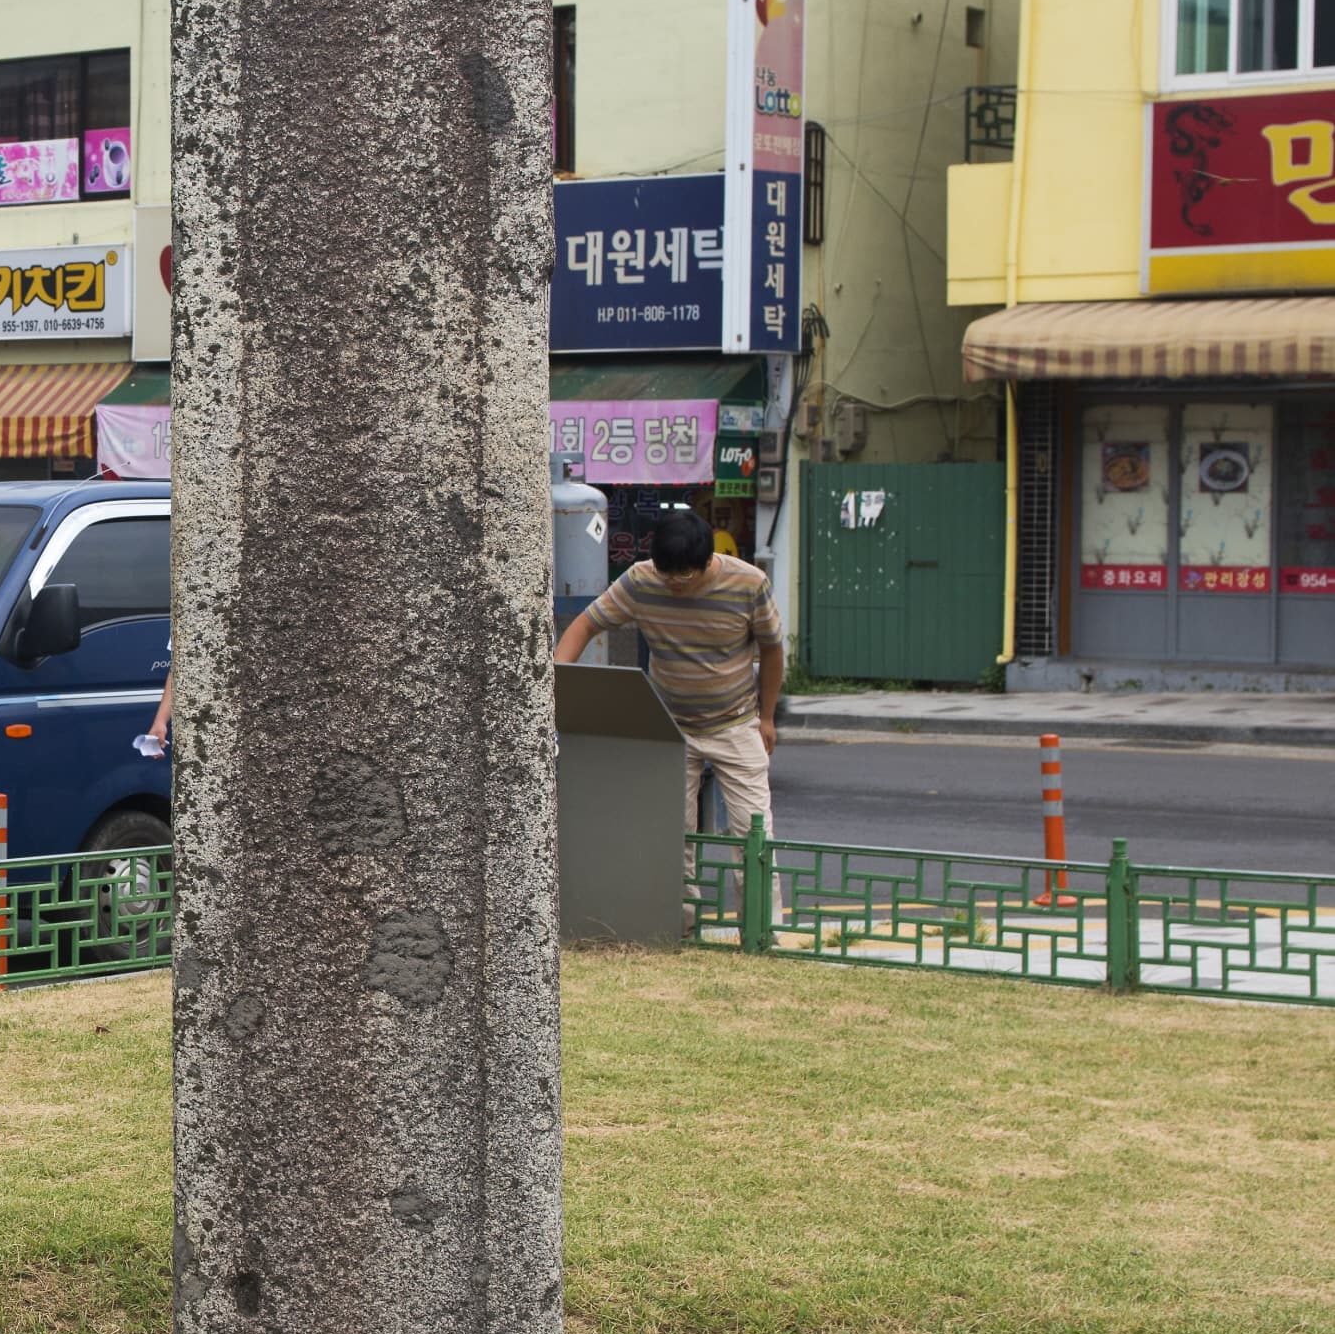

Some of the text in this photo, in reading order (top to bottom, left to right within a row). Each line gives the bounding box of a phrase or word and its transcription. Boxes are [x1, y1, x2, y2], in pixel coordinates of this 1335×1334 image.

[756, 85, 802, 118] Lotto
[763, 180, 787, 340] 대원세탁
[616, 304, 700, 322] 011-806-1178
[43, 317, 105, 332] 010-6639-4756
[591, 417, 636, 465] 2등
[644, 416, 698, 465] 당첨
[720, 447, 753, 466] LOTTO
[1102, 569, 1163, 586] 중화요리
